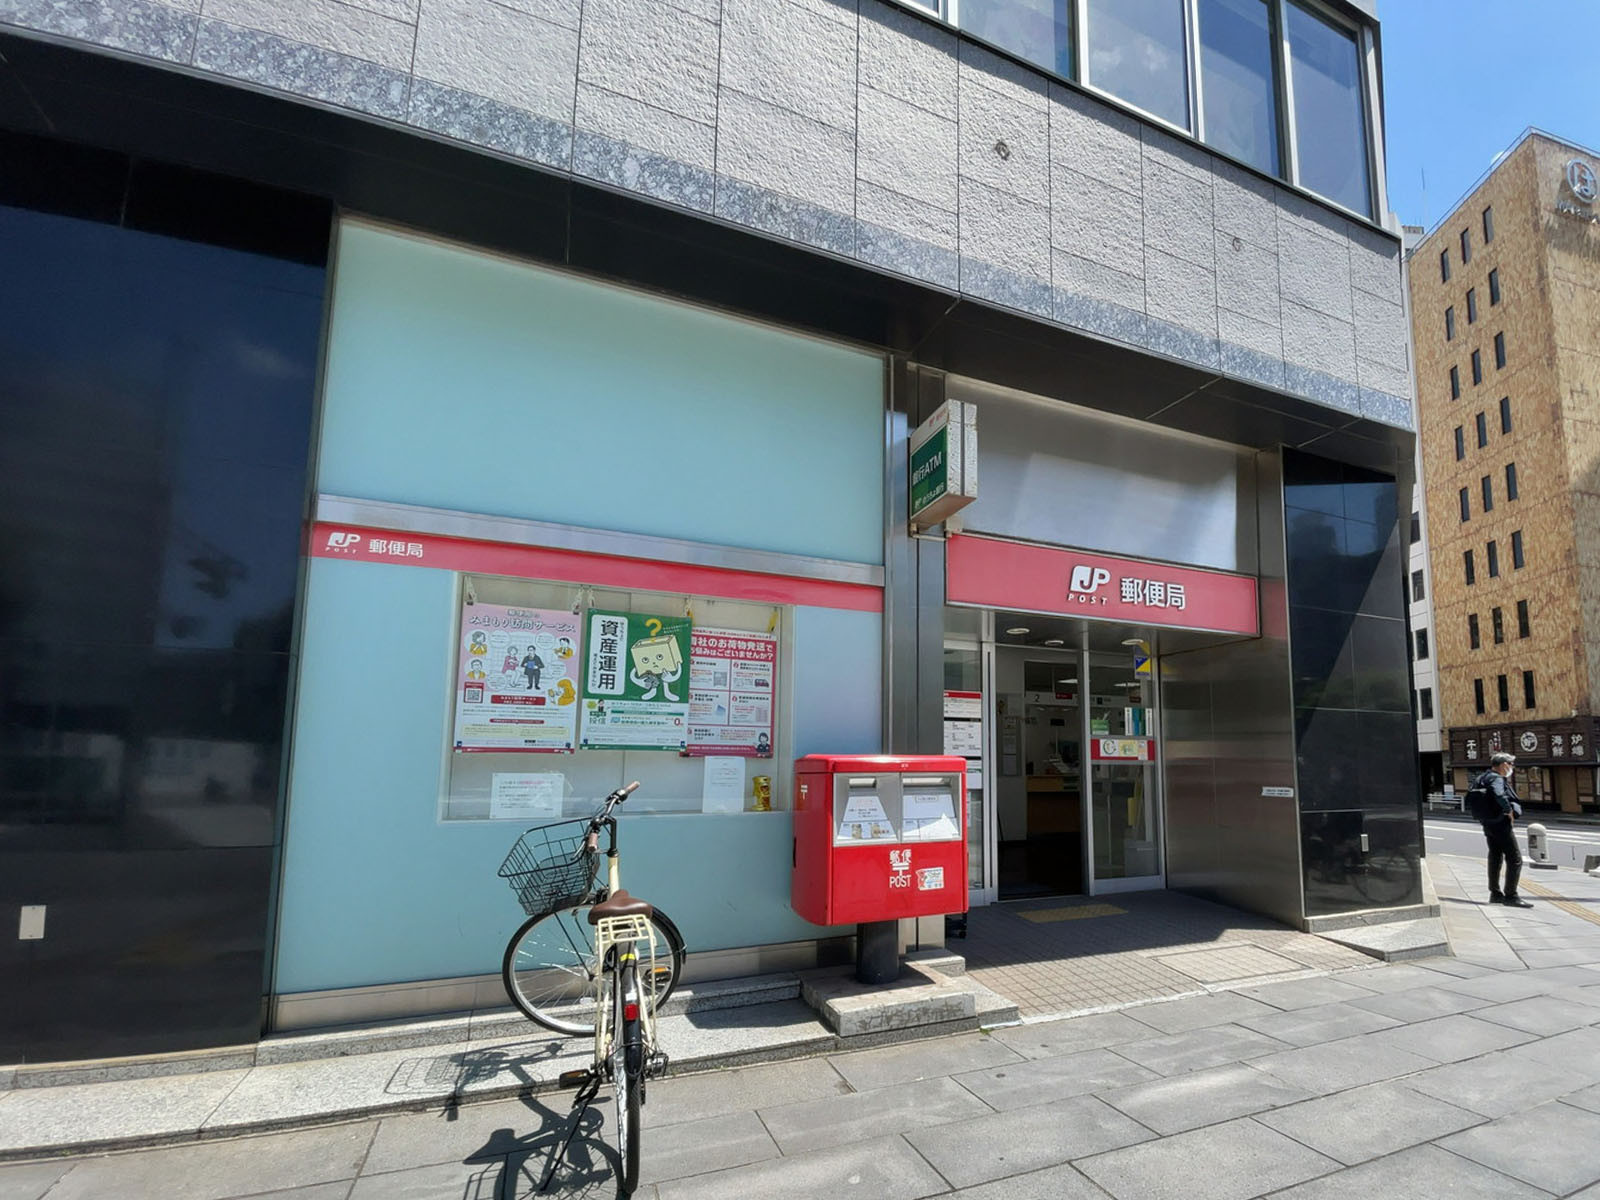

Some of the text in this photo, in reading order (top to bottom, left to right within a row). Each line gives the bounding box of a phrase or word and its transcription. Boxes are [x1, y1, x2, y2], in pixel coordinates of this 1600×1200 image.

[327, 532, 361, 547] JP
[368, 538, 424, 558] 郵便局
[1069, 565, 1111, 593] JP
[1067, 593, 1108, 605] POST
[1120, 577, 1186, 610] 郵便局
[597, 619, 619, 690] 資産運用
[890, 849, 912, 864] 郵便
[889, 875, 912, 889] POST
